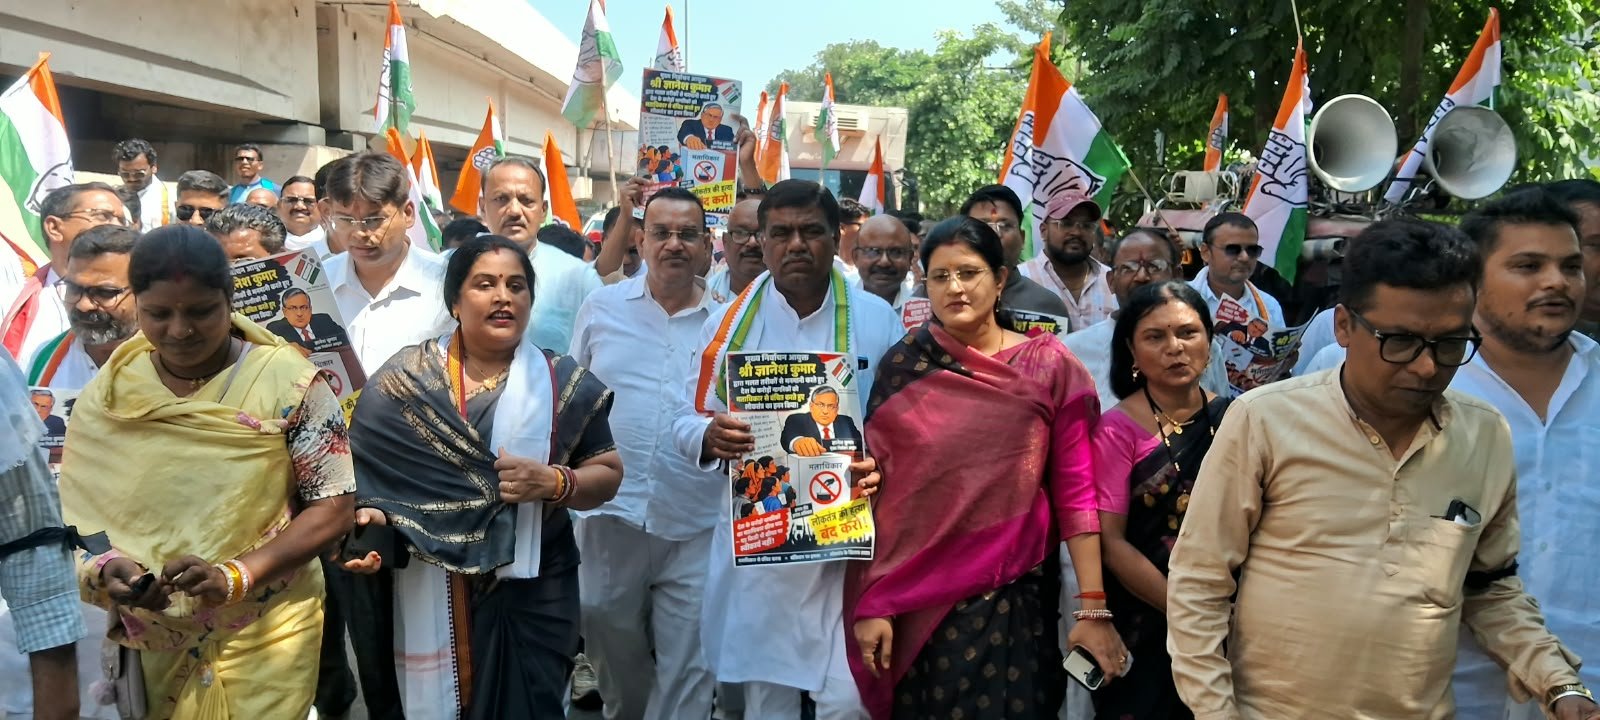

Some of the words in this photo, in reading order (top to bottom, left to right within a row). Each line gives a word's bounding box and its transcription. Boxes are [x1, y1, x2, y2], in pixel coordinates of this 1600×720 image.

[650, 77, 661, 88] श्री
[663, 79, 689, 90] ज्ञानेश
[690, 83, 712, 93] कुमार
[713, 185, 720, 193] की
[721, 184, 733, 192] हत्या
[712, 192, 732, 204] करो!
[252, 269, 278, 288] कुमार
[745, 354, 760, 363] मुख्य
[762, 352, 786, 360] निर्वाचन
[789, 354, 809, 363] आयुक्त
[739, 362, 753, 377] श्री
[755, 362, 788, 377] ज्ञानेश
[790, 363, 816, 377] कुमार
[808, 461, 843, 470] मताधिकार
[811, 512, 836, 526] लोकतंत्र
[838, 508, 848, 520] की
[850, 503, 865, 516] हत्या
[820, 524, 838, 539] बंद
